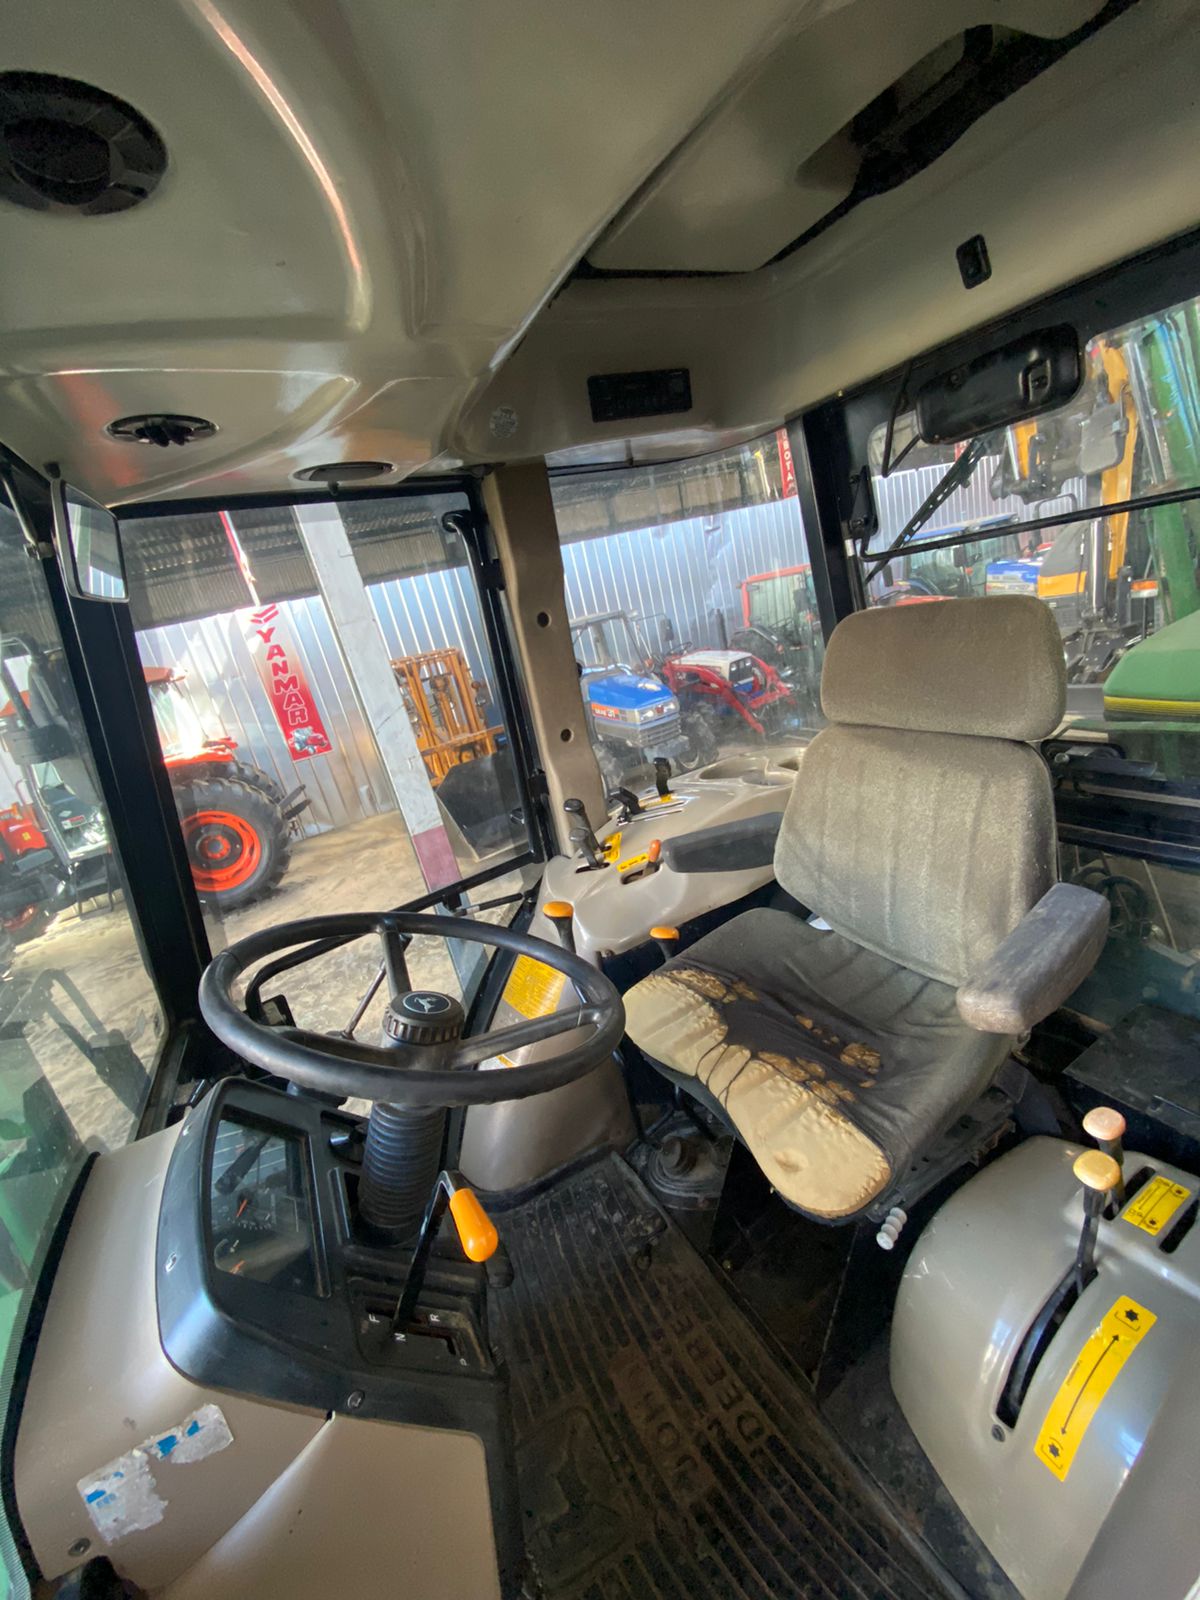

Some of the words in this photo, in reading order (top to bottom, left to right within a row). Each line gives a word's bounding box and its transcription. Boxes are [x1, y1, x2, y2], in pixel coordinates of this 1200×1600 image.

[255, 626, 308, 726] YANMAR
[626, 1362, 698, 1471] JOH
[669, 1314, 765, 1442] DEERE
